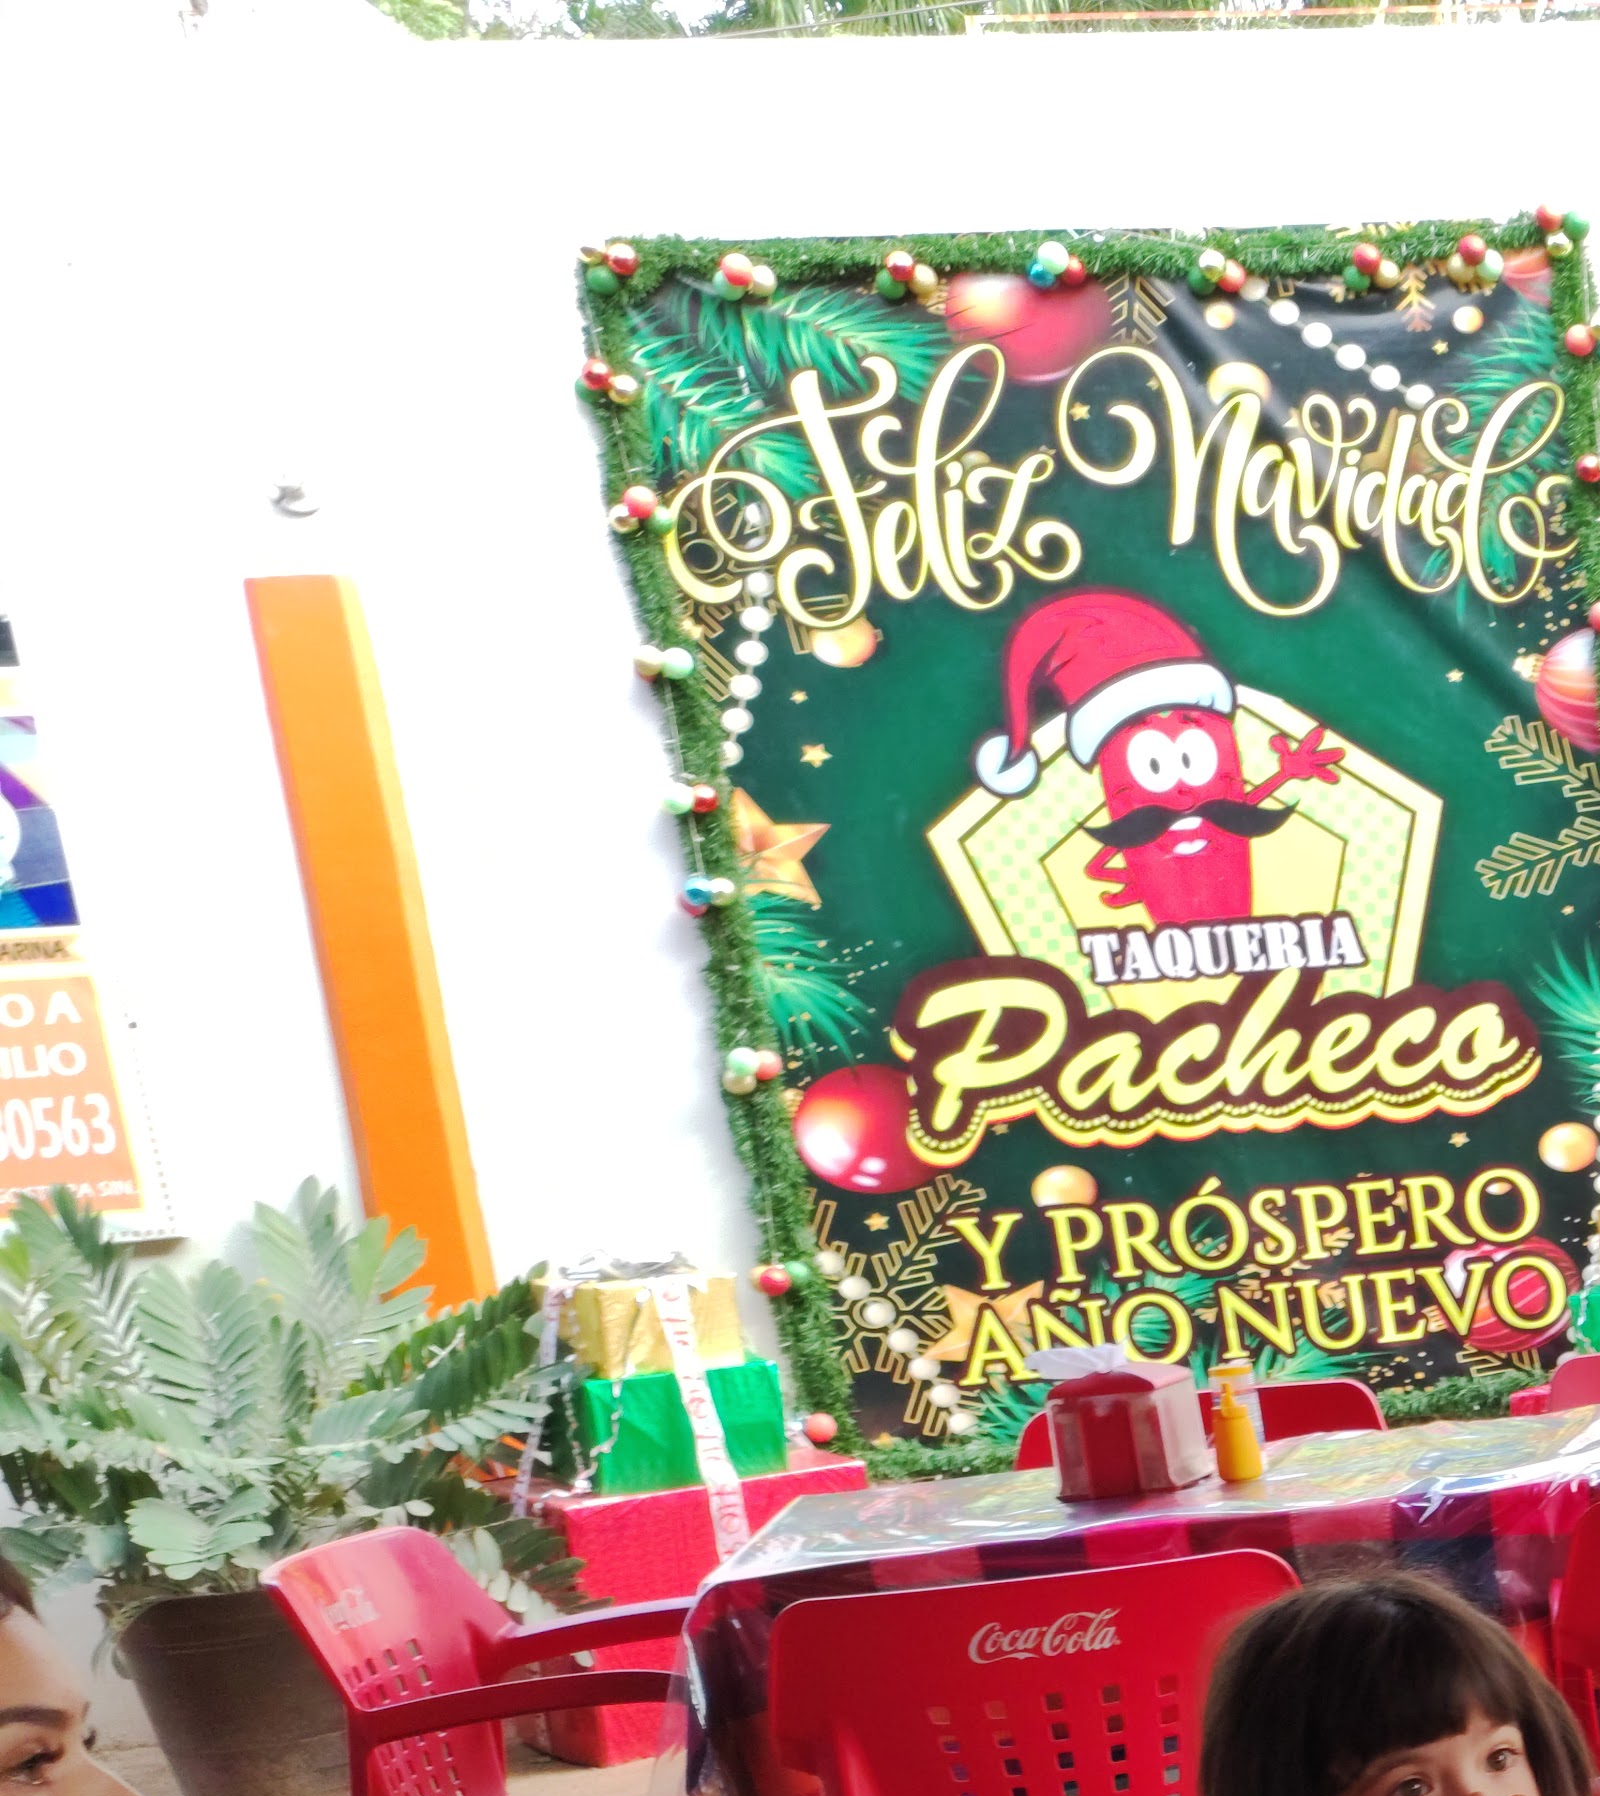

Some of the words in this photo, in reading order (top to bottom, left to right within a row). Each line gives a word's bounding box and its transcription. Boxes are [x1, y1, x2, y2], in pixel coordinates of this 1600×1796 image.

[664, 343, 1082, 630] Feliz
[1058, 345, 1580, 617] Navidad
[1082, 916, 1366, 984] TAQUERIA
[915, 966, 1520, 1133] Pacheco
[949, 1212, 1024, 1291] Y
[1044, 1167, 1542, 1285] PRÓSPERO
[958, 1288, 1194, 1388] AÑO
[1218, 1255, 1569, 1362] NUEVO
